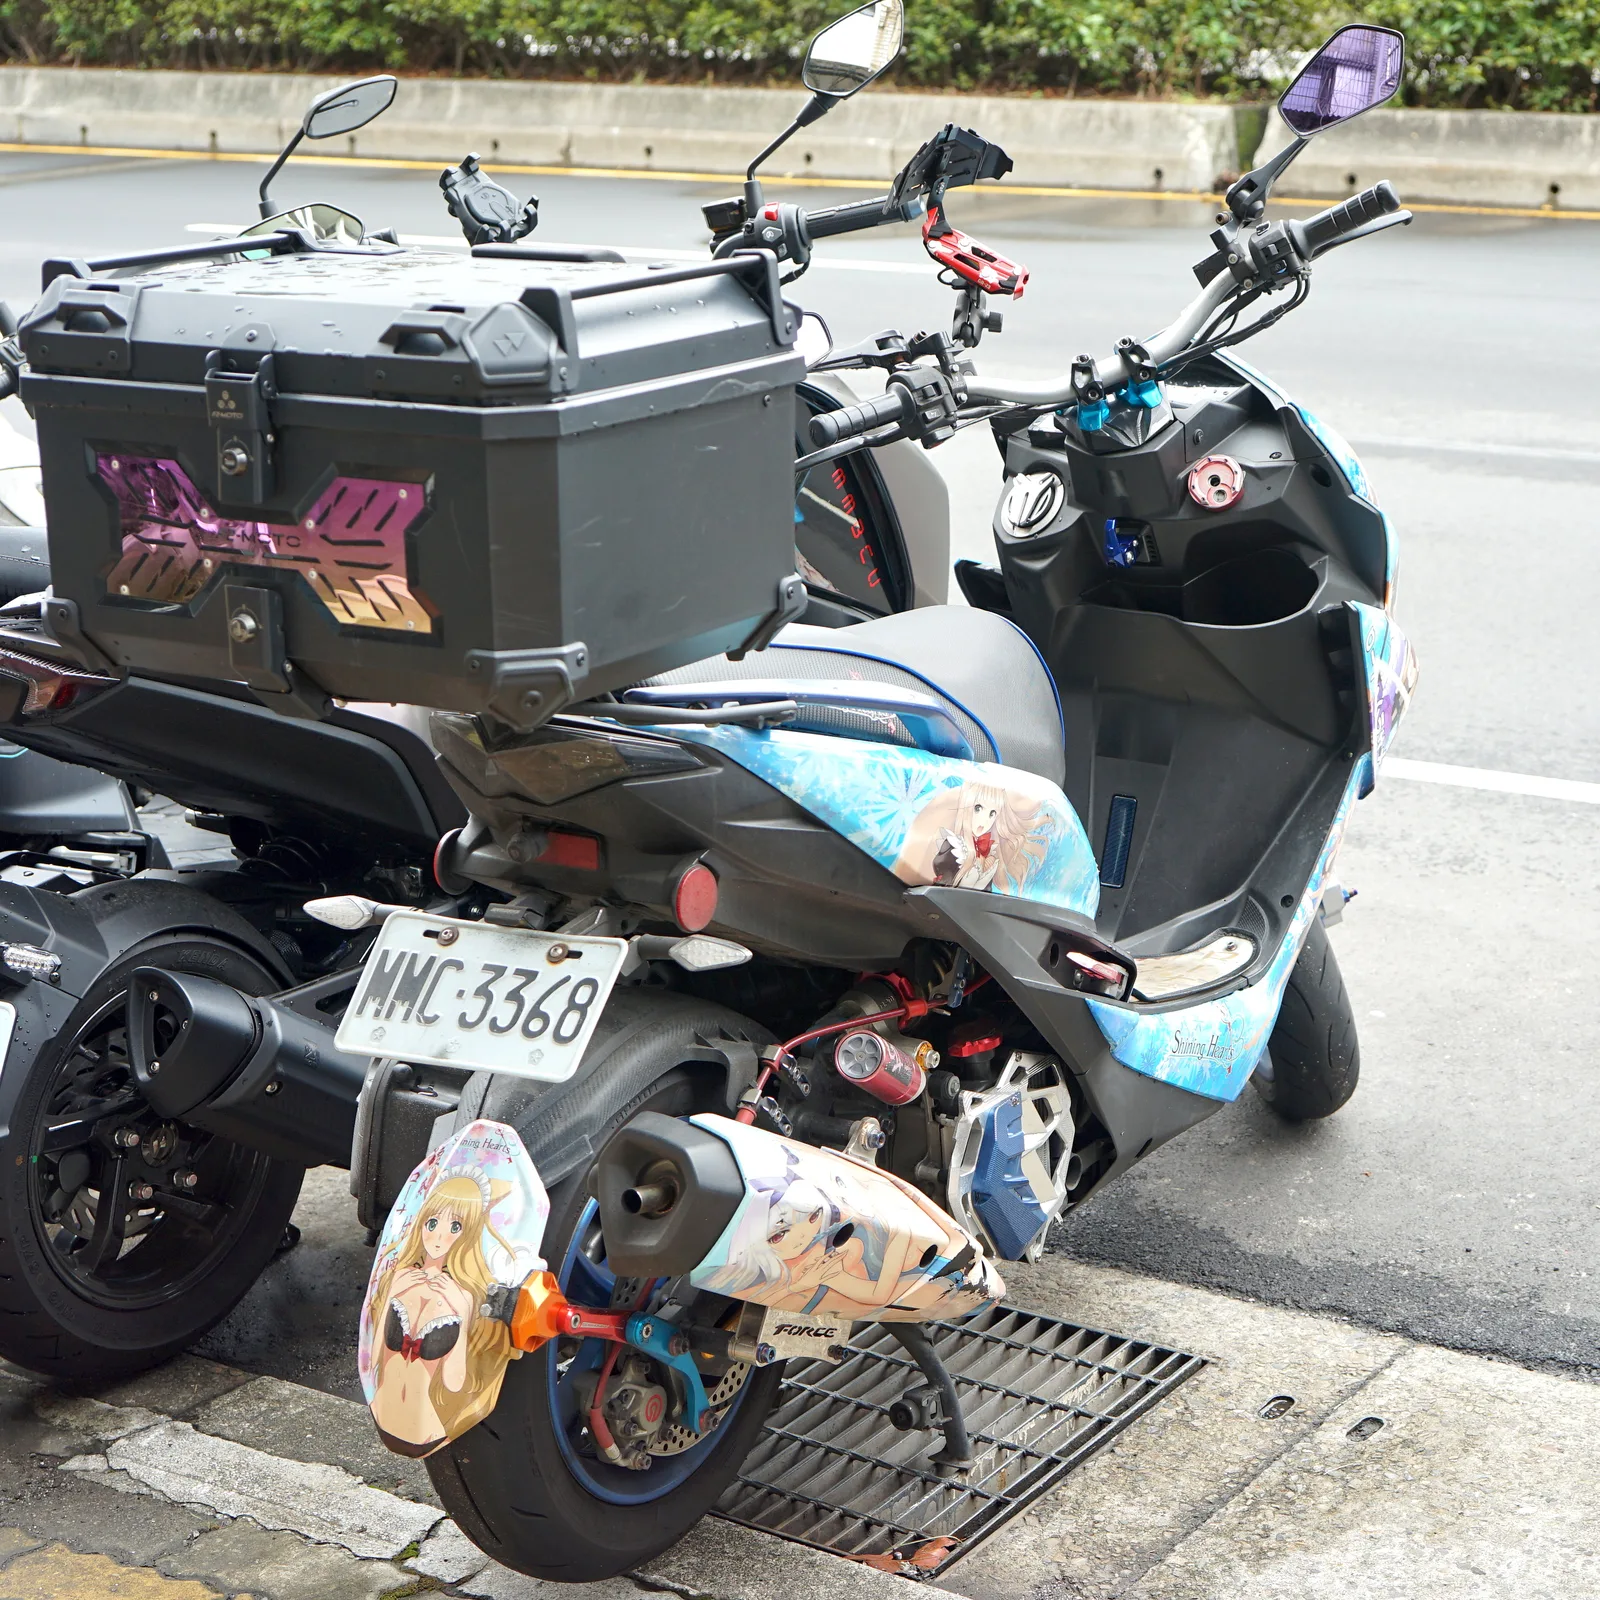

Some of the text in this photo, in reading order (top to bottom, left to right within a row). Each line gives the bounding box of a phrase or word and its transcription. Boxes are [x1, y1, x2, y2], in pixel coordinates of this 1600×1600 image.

[1171, 1029, 1235, 1060] Shining Hearts
[482, 1138, 511, 1155] Hearts
[772, 1323, 838, 1338] FORCE
